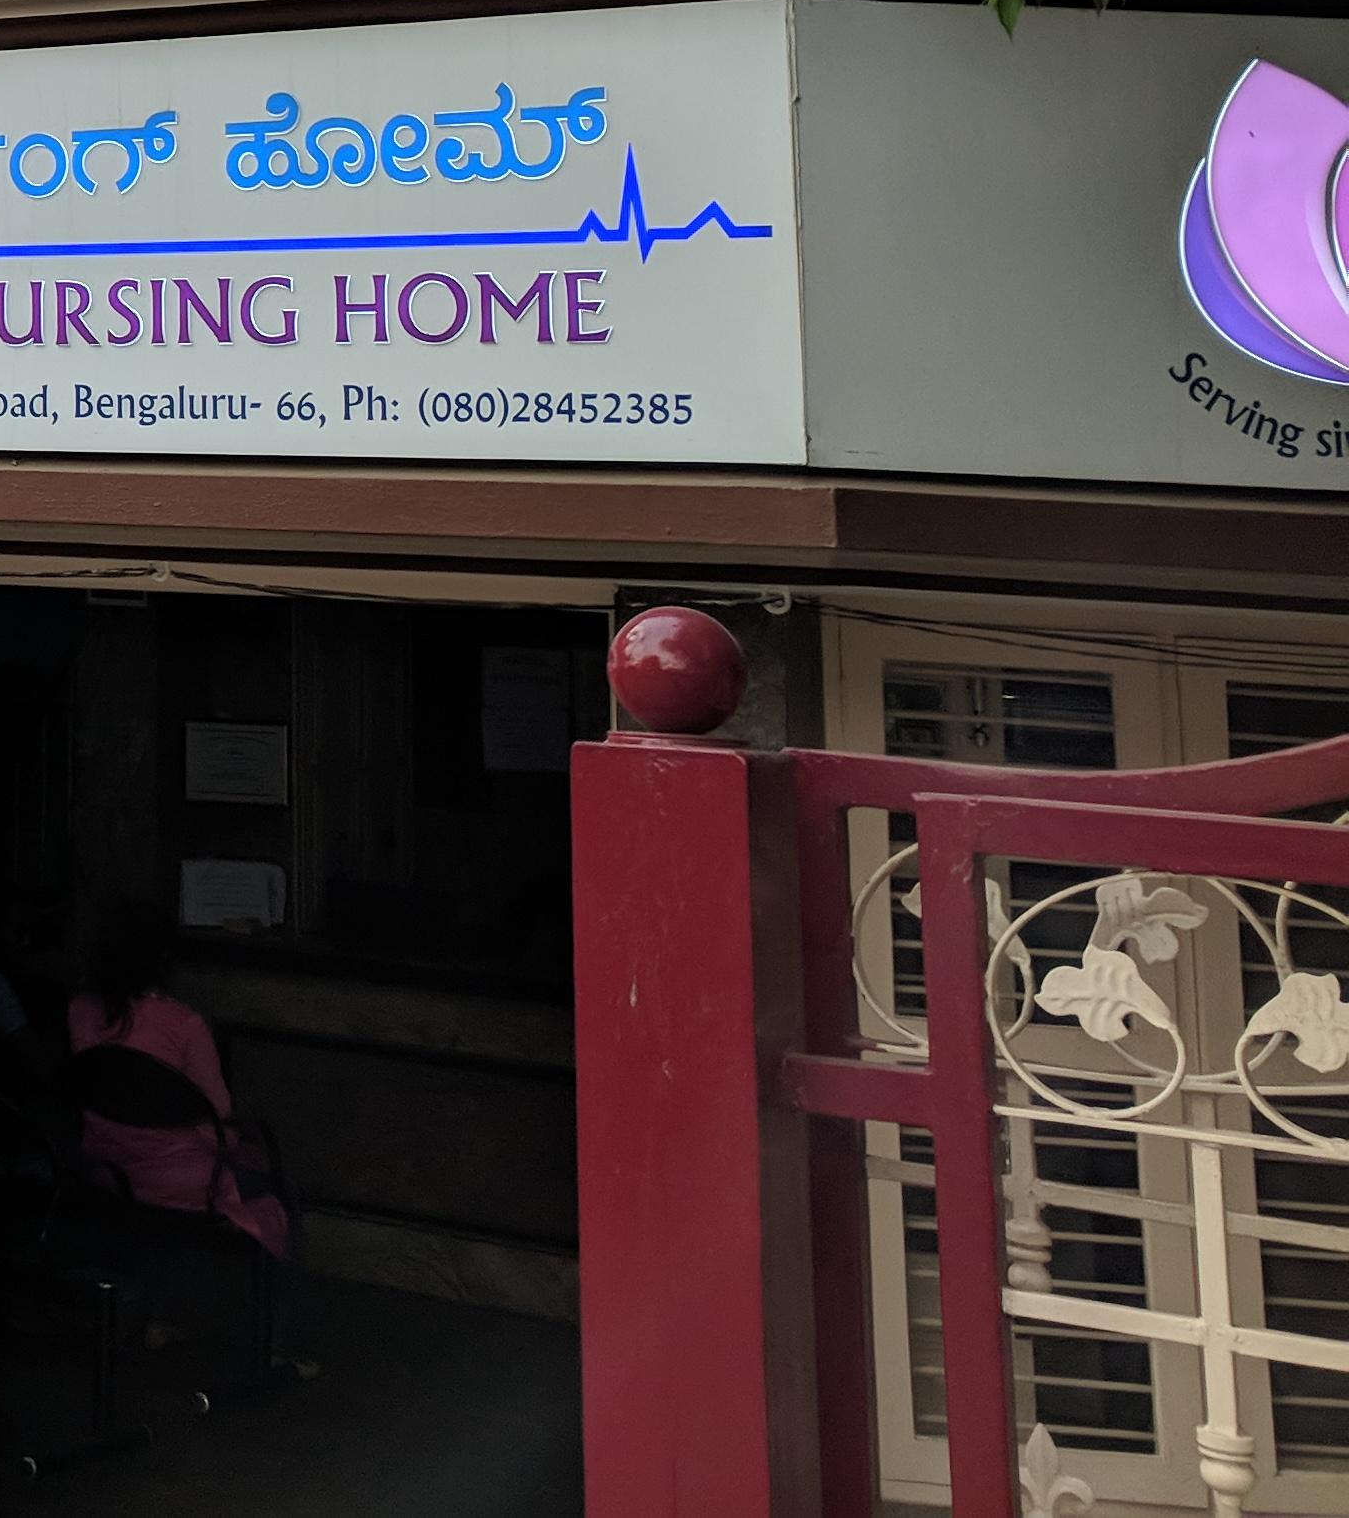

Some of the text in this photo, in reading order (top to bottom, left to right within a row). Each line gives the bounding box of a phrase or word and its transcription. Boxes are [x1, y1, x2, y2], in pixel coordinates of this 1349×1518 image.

[225, 82, 607, 192] ಹೋಮ್
[334, 269, 614, 345] HOME
[74, 384, 262, 426] Bengaluru-
[276, 391, 326, 428] 66,
[342, 385, 401, 423] Ph:
[418, 387, 694, 429] (080)28452385
[1168, 352, 1305, 458] Serving
